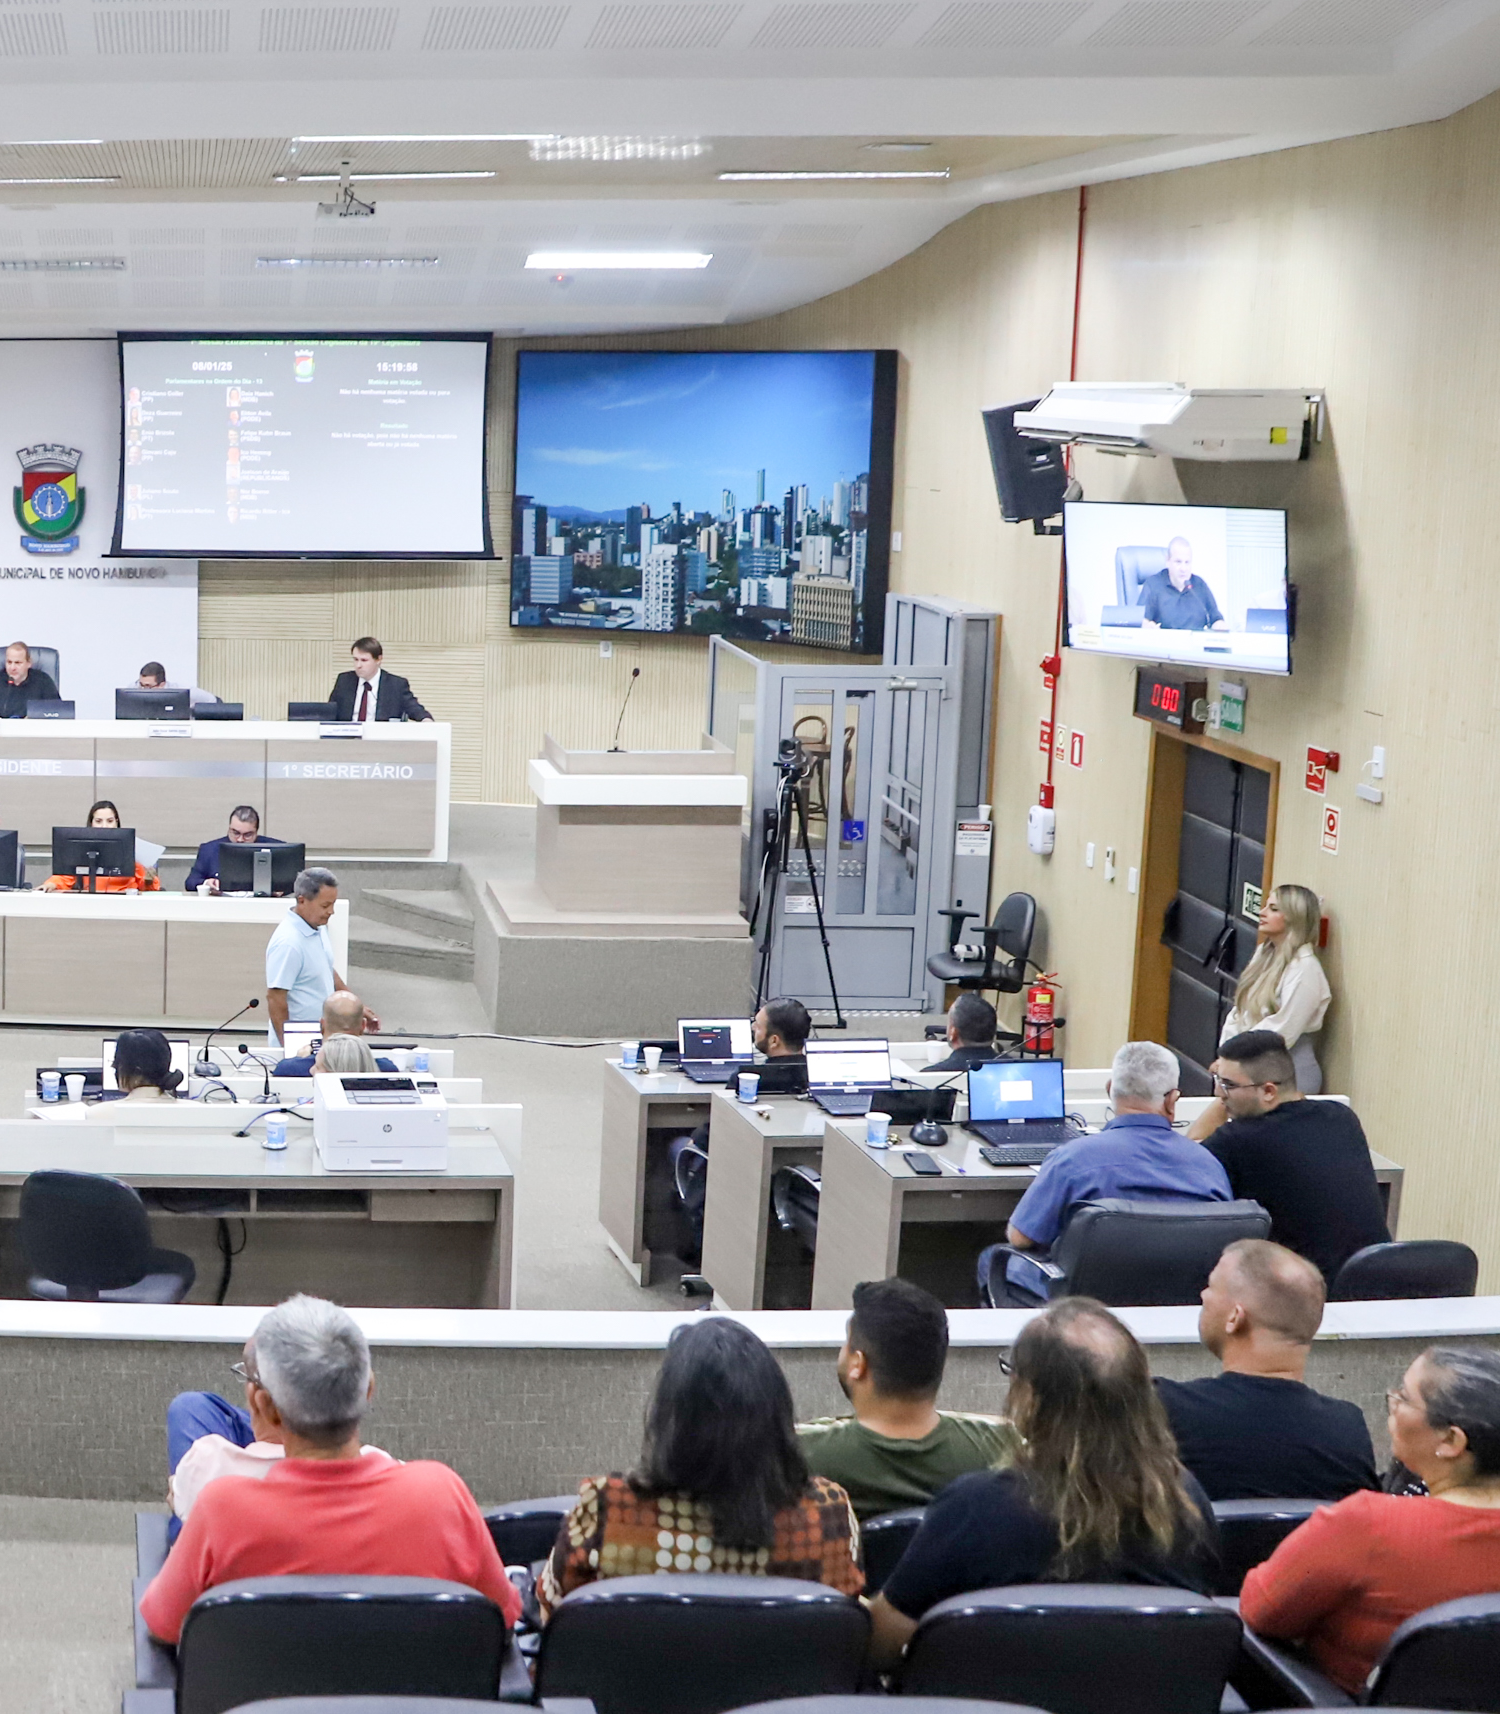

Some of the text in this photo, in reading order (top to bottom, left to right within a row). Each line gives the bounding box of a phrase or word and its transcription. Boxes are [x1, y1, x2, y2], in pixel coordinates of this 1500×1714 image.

[192, 361, 233, 371] 08/01/25
[376, 362, 418, 372] 15:19:58
[49, 567, 64, 580] DE
[68, 567, 100, 580] NOVO
[302, 762, 414, 780] SECRETÁRIO
